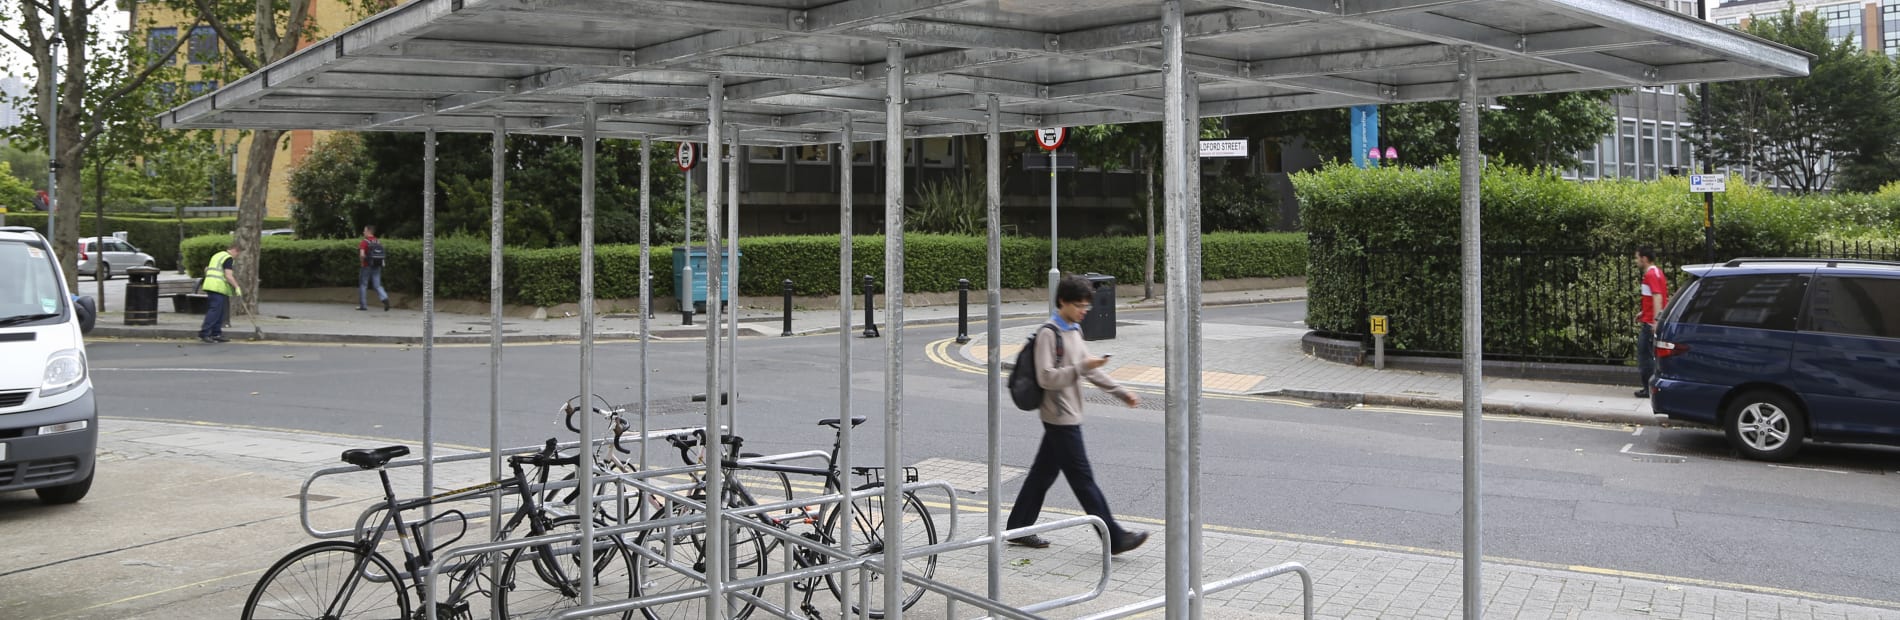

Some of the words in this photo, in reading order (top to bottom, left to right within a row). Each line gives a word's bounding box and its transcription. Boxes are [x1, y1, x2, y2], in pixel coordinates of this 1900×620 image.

[1200, 142, 1220, 151] LDFORD
[1221, 142, 1241, 151] STREET
[1693, 176, 1700, 185] P
[1373, 319, 1384, 332] H
